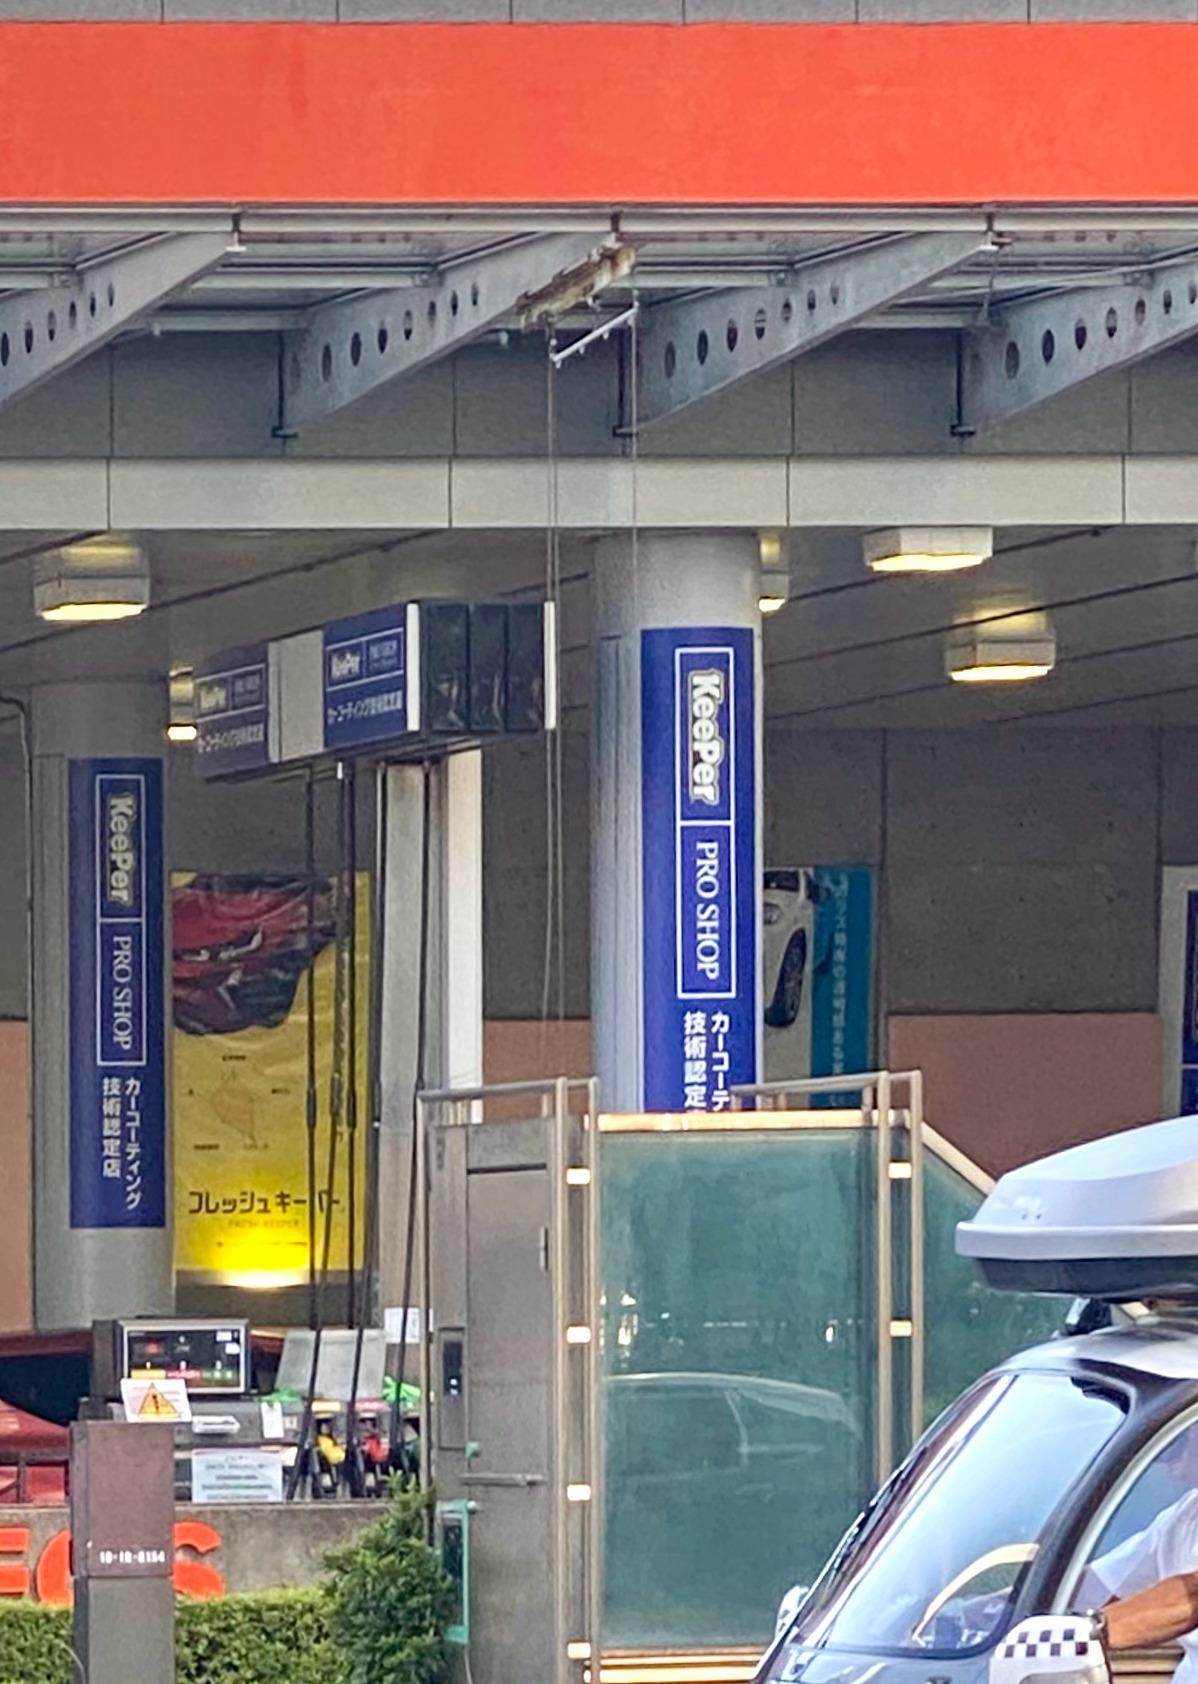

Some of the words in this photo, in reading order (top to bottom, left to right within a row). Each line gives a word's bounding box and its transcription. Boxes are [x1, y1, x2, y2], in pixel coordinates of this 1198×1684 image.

[690, 670, 723, 804] KeePer
[108, 794, 137, 905] KeePer
[696, 841, 720, 899] PRO
[113, 936, 132, 983] PRO
[696, 903, 720, 980] SHOP
[113, 987, 132, 1050] SHOP
[684, 1011, 707, 1112] 技術認定
[102, 1077, 121, 1178] 技術認定店
[125, 1077, 142, 1210] カーコーティング
